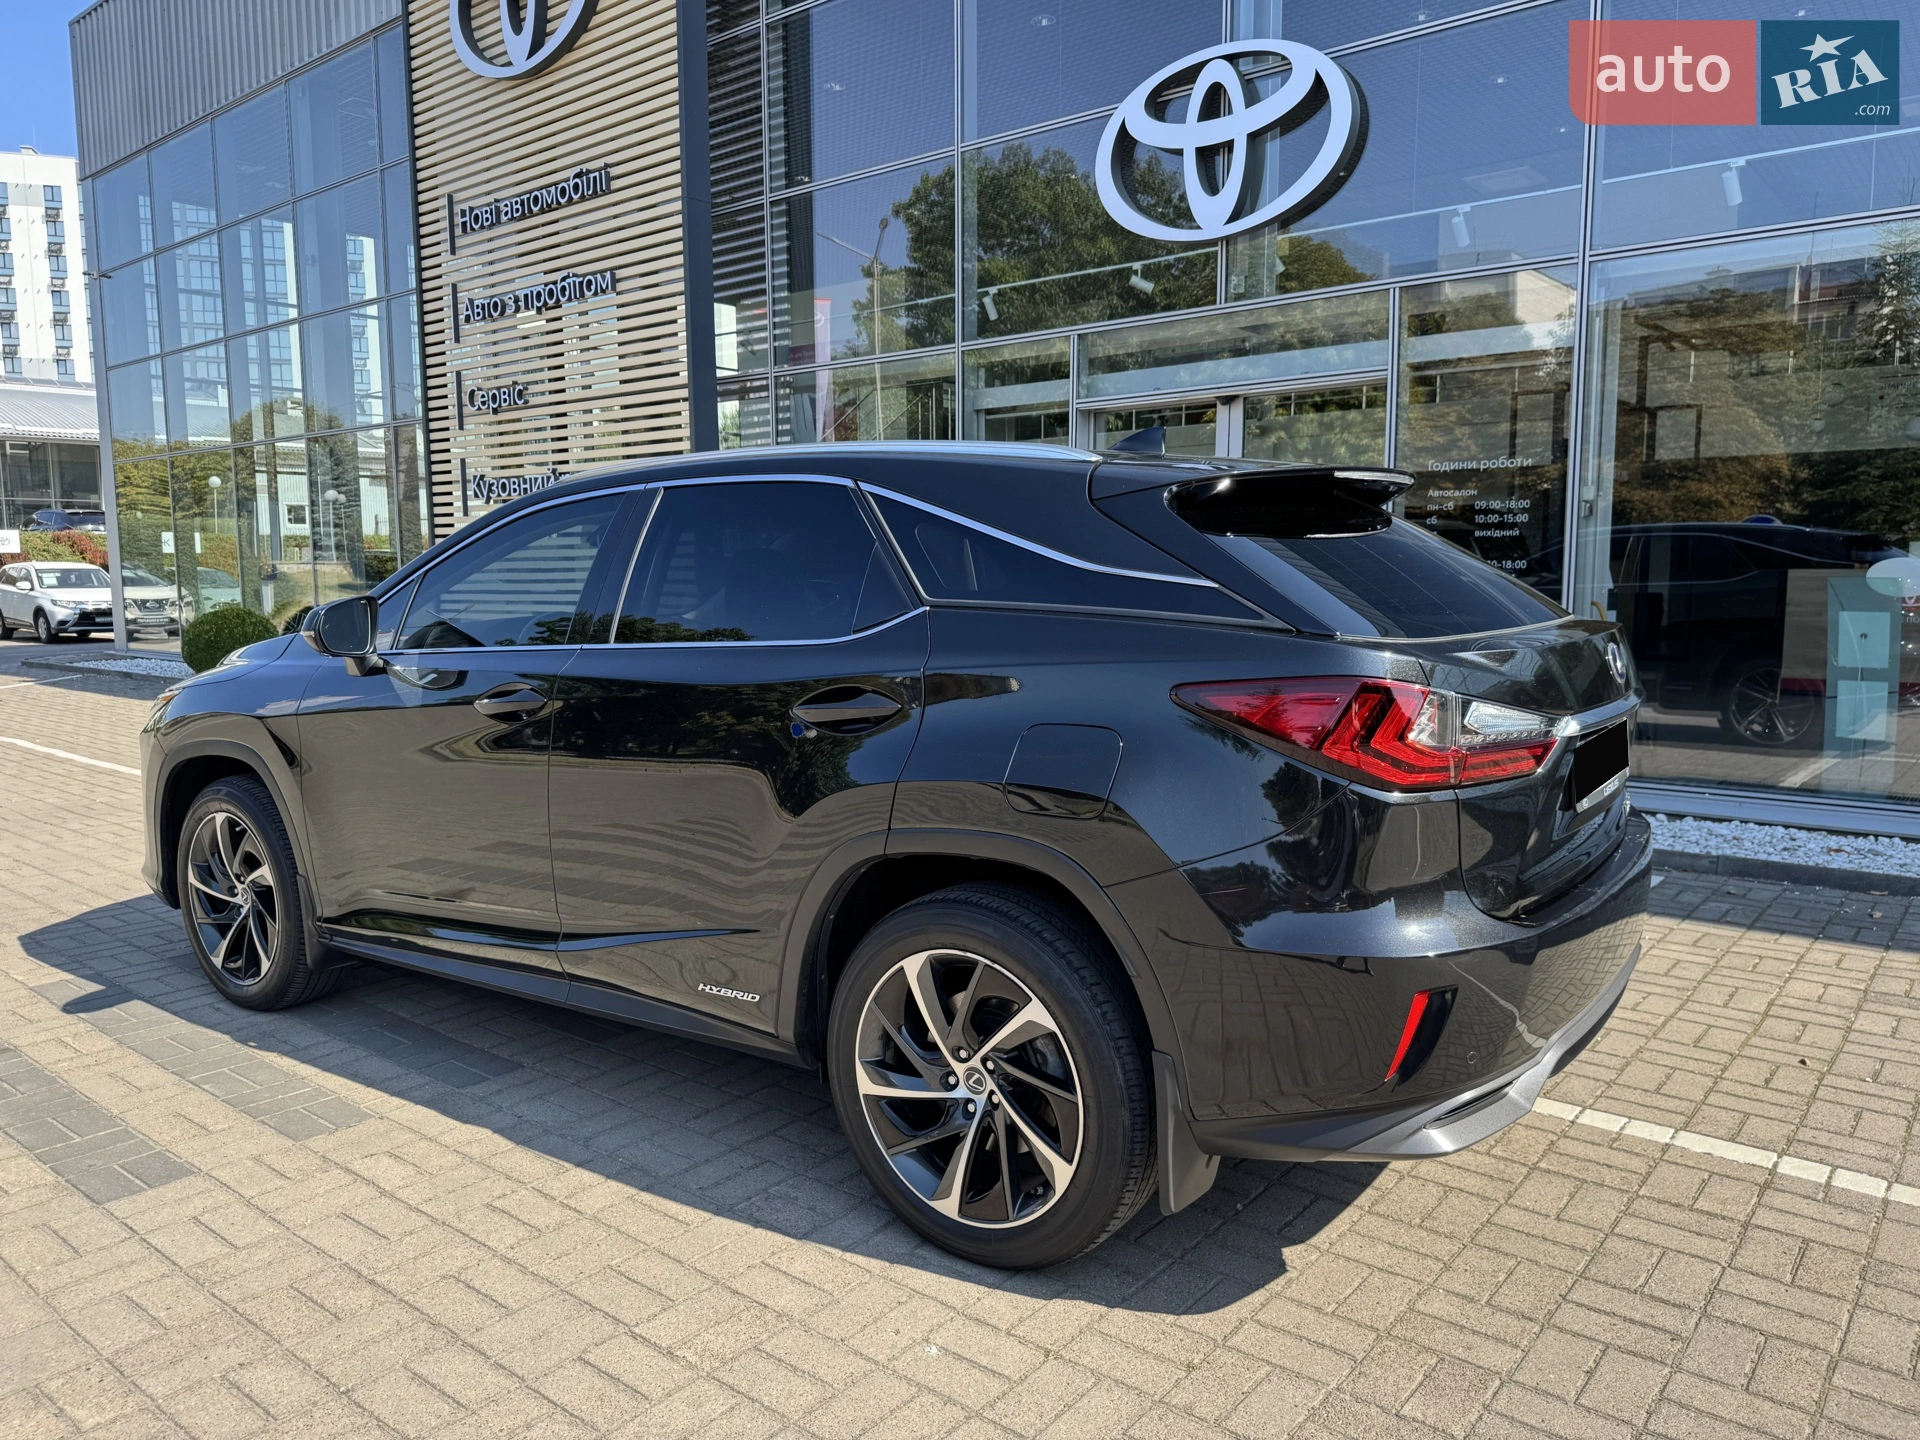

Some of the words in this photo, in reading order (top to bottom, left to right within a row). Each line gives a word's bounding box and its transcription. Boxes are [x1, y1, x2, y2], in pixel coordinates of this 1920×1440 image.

[458, 197, 500, 233] Нові
[501, 162, 610, 221] автомобілі
[463, 297, 503, 323] Авто
[506, 294, 520, 314] з
[522, 271, 614, 315] пробігом
[466, 381, 526, 415] Сервіс
[1428, 460, 1477, 472] Години
[1480, 456, 1532, 472] роботи
[1427, 489, 1478, 498] Автосалон
[1474, 500, 1531, 510] 09:00-18:00
[1426, 515, 1438, 525] сб
[1474, 513, 1529, 524] 10:00-15:00
[1474, 528, 1520, 538] вихідний
[697, 983, 760, 1002] HYBRID
